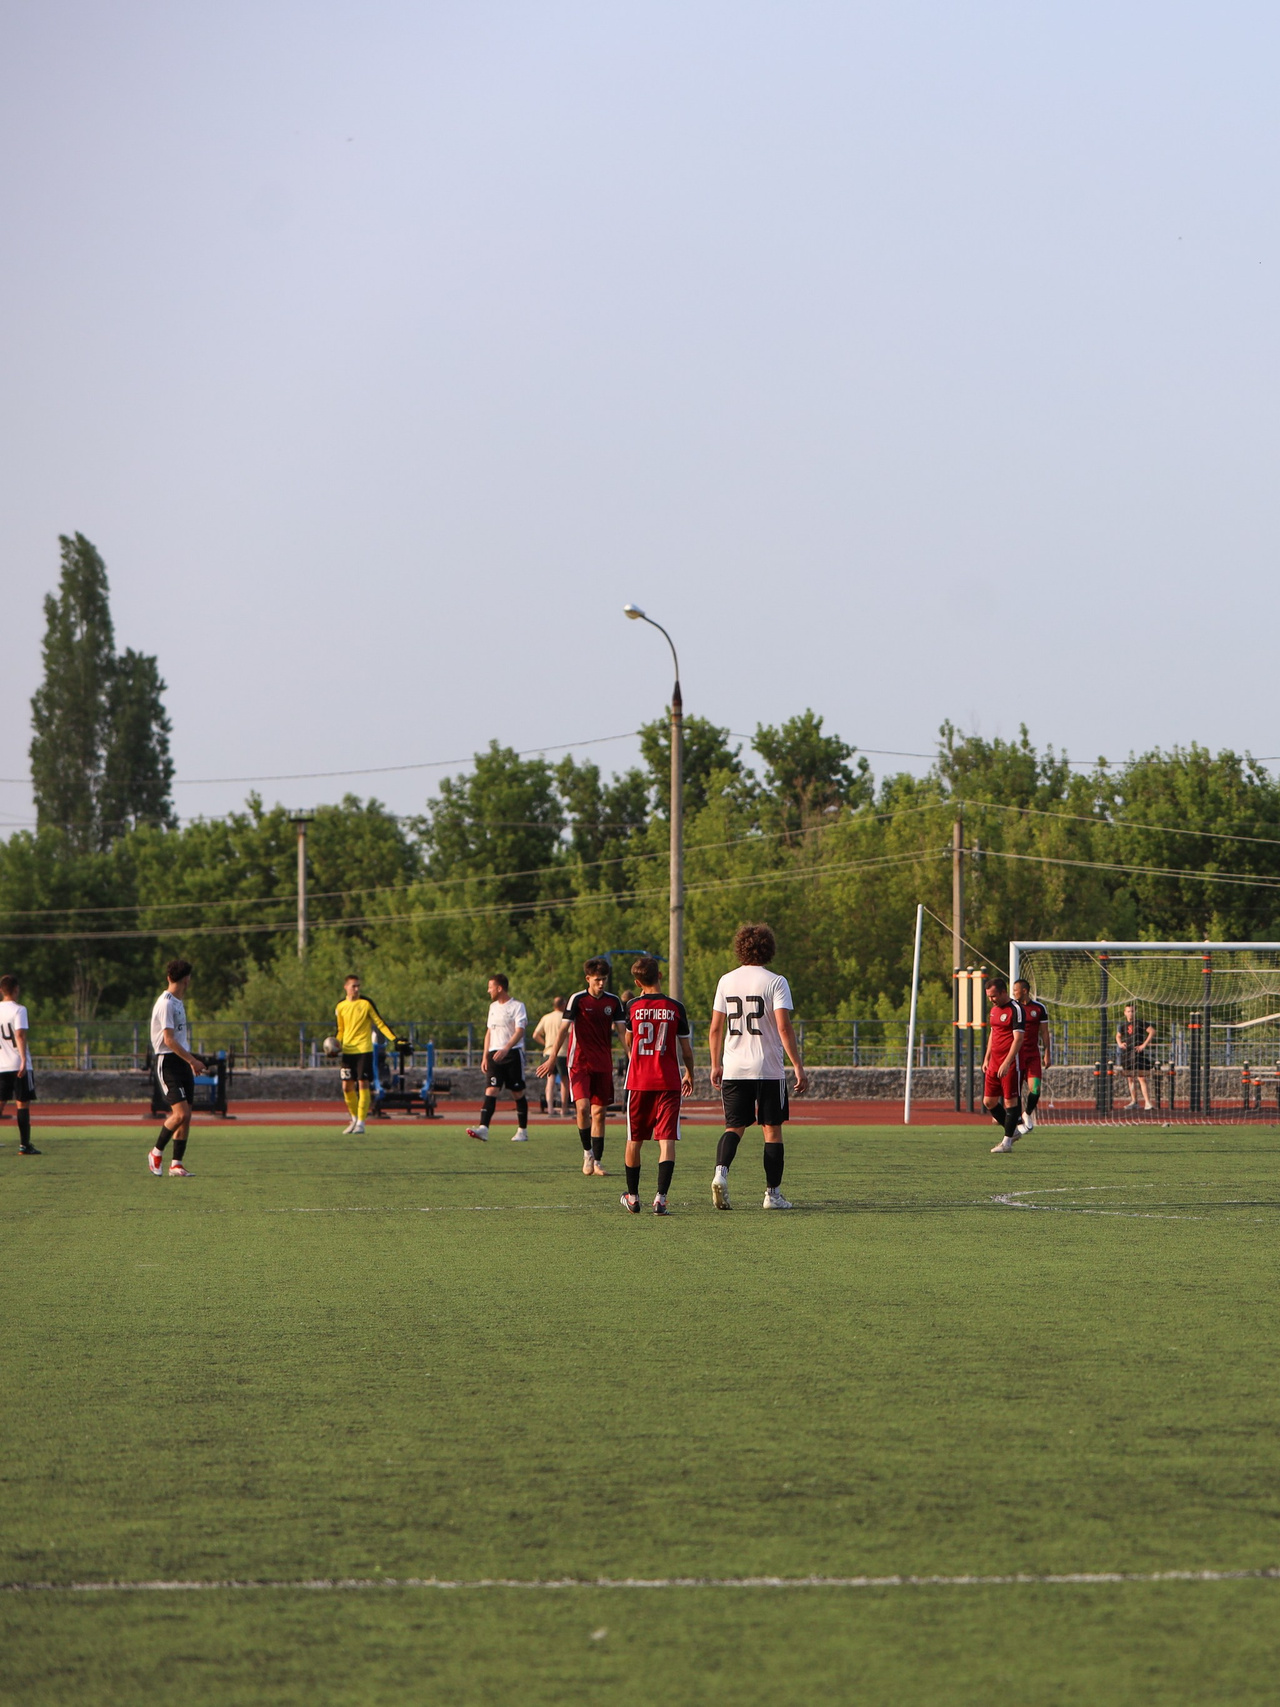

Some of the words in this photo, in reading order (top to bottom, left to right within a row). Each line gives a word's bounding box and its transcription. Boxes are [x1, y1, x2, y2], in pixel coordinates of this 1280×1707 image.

[635, 1008, 675, 1021] СЕРГИЕВСК
[726, 995, 765, 1036] 22
[0, 1022, 17, 1049] 4
[638, 1021, 669, 1056] 24
